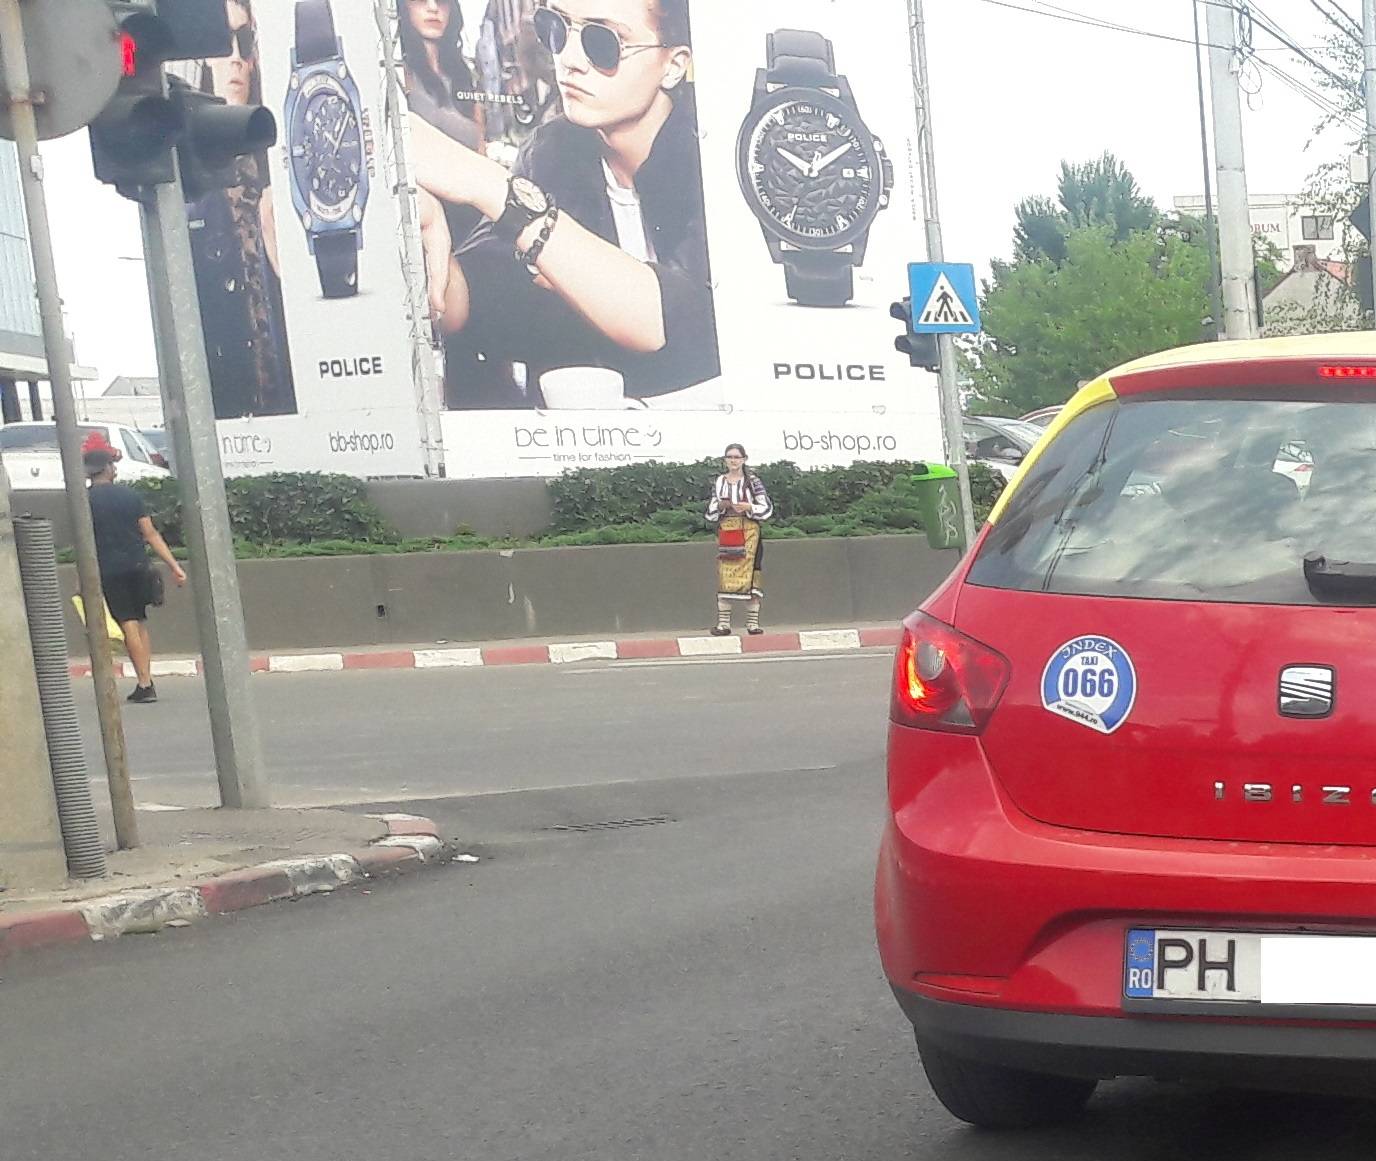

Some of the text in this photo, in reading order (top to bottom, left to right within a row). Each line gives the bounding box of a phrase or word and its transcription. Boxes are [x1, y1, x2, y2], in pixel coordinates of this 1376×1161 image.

[456, 91, 524, 105] QUIET REBELS
[787, 133, 828, 142] POLICE
[319, 356, 383, 378] POLICE
[773, 362, 886, 381] POLICE
[329, 430, 394, 454] bb-shop.ro
[515, 426, 549, 447] be
[555, 426, 577, 447] in
[783, 430, 897, 455] bb-shop.ro
[553, 452, 632, 462] time for fashion
[1061, 639, 1118, 660] INDEX
[1081, 656, 1098, 666] TAXI
[1062, 667, 1115, 698] 066
[1056, 704, 1098, 725] www.944.ro
[1157, 938, 1236, 992] PH
[1129, 968, 1152, 989] RO
